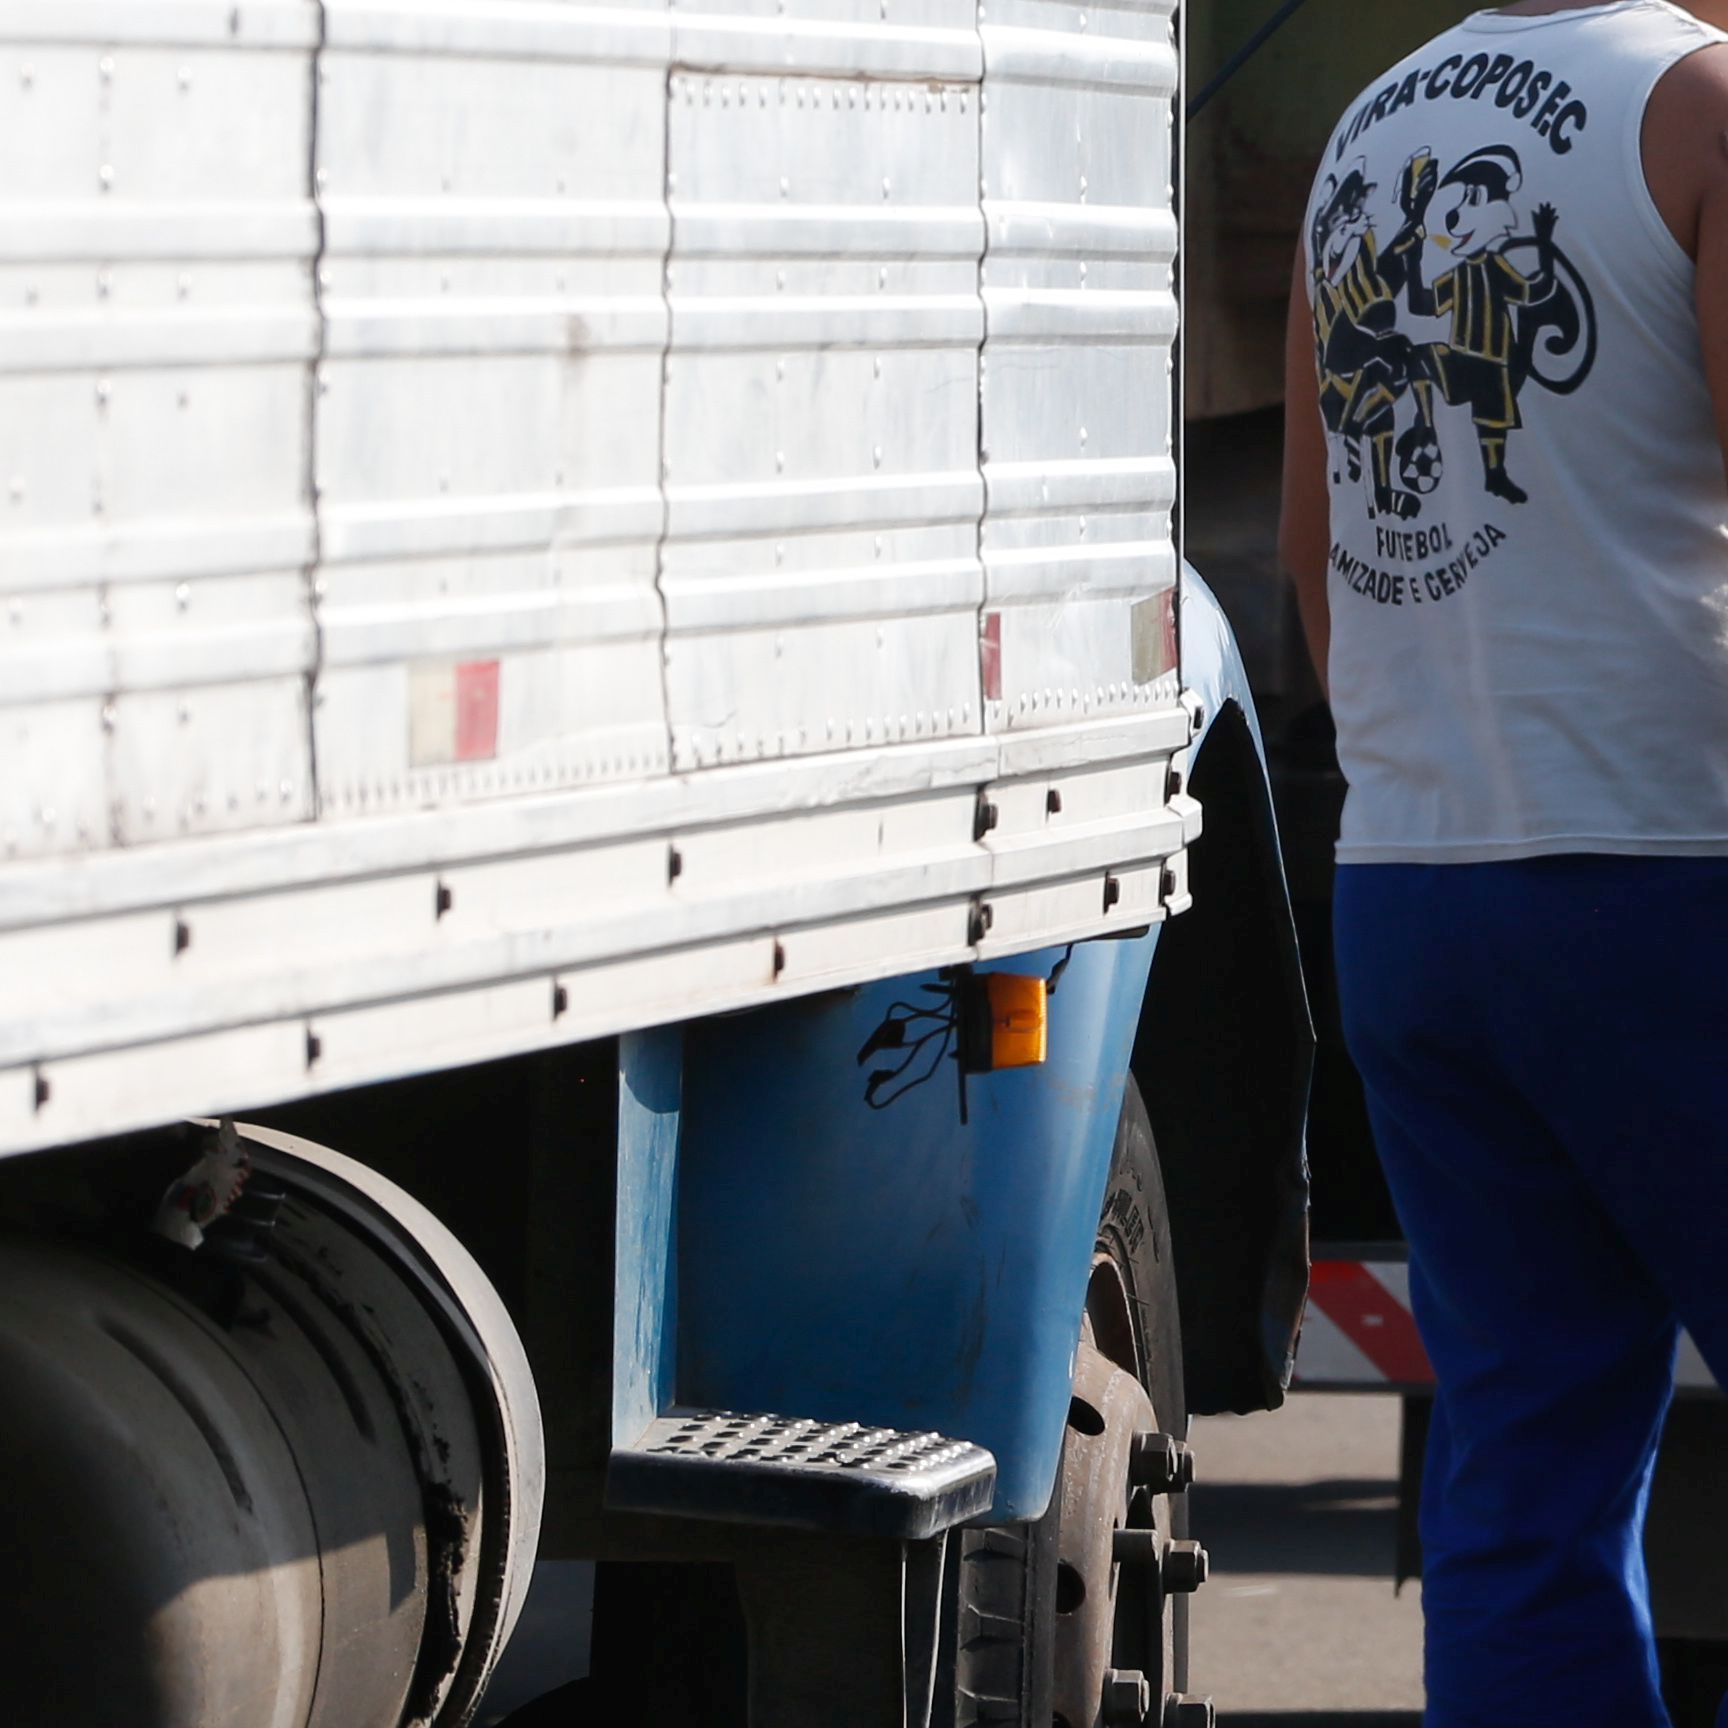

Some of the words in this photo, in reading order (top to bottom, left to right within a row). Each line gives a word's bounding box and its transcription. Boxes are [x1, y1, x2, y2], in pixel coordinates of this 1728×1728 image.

[1329, 542, 1404, 605] AMIZADE
[1409, 577, 1422, 604] E
[1424, 523, 1507, 602] CERVEJA
[1376, 522, 1453, 562] FUTEBOL
